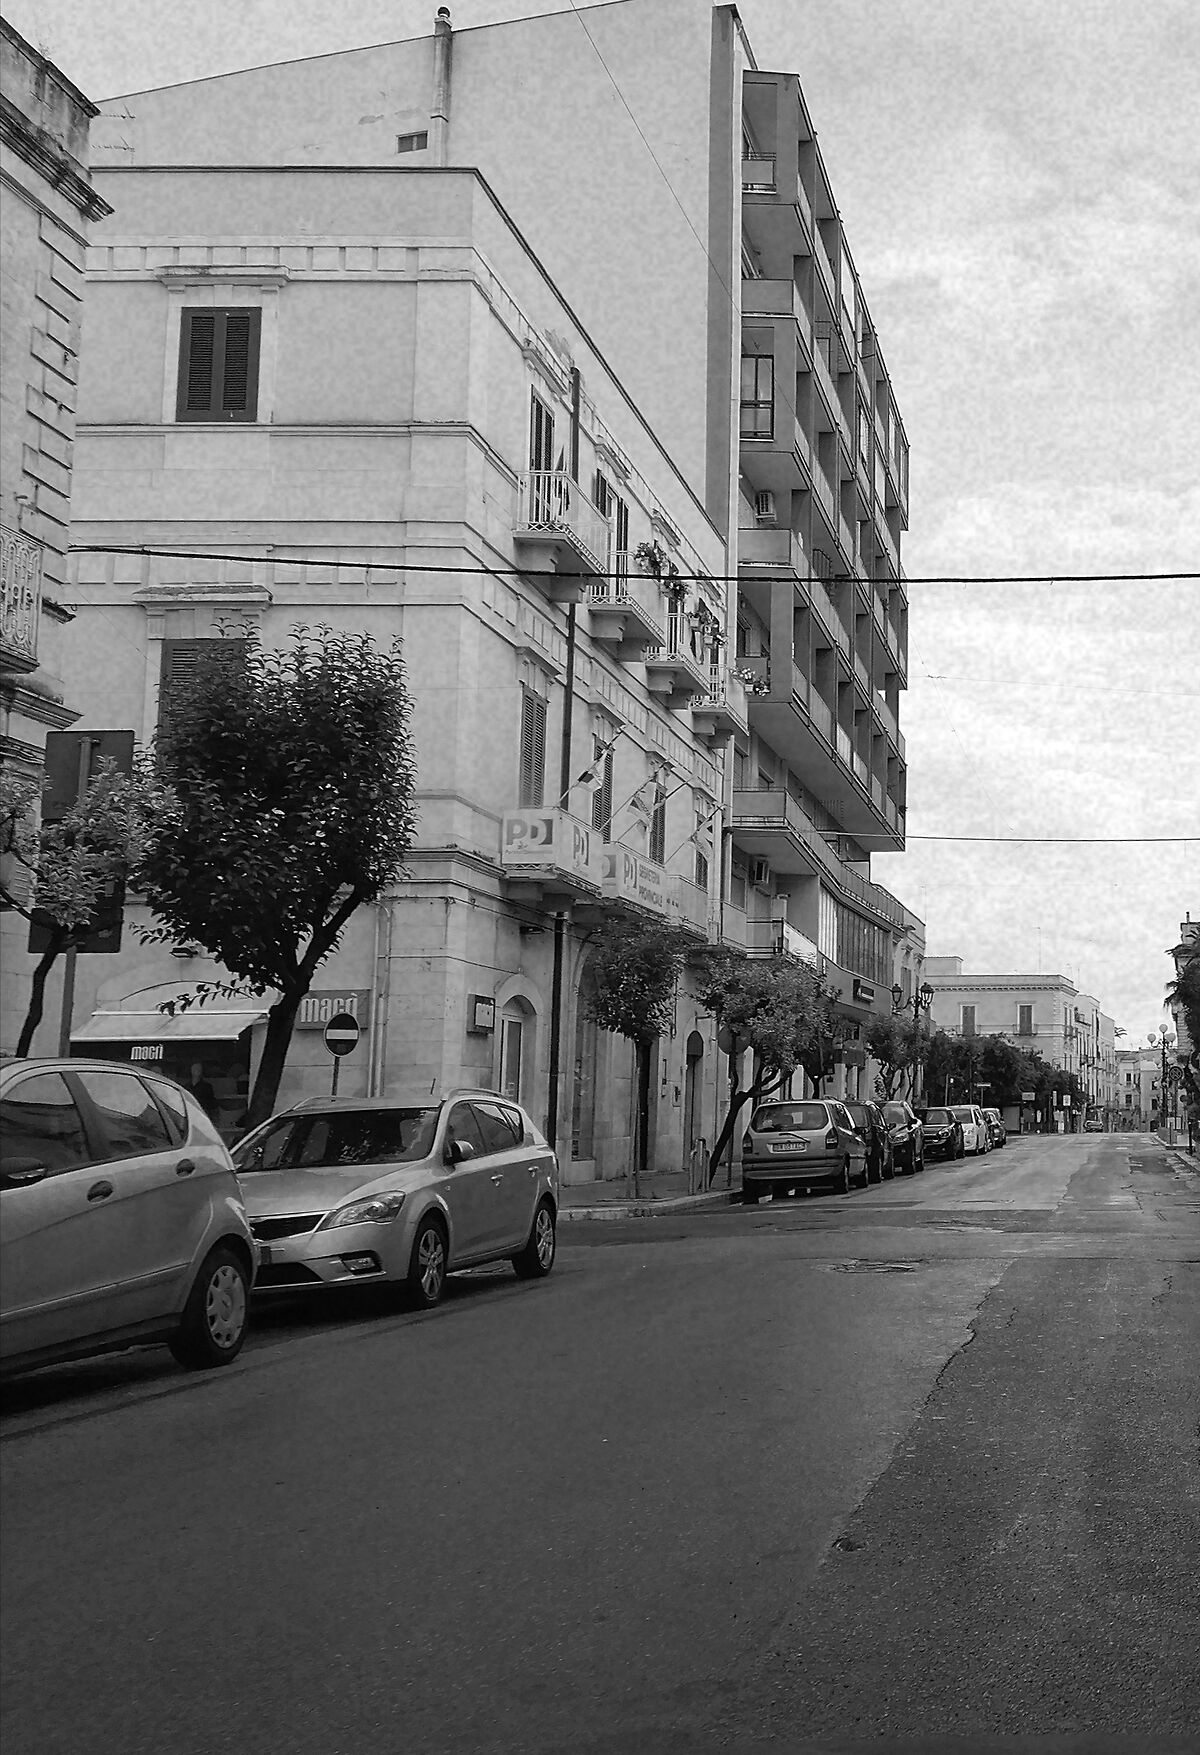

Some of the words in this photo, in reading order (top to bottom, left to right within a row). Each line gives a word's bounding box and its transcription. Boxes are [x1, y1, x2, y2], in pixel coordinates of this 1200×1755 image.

[506, 819, 553, 846] PD
[573, 825, 589, 867] PD
[623, 853, 638, 889] PD
[130, 1043, 164, 1060] macrì
